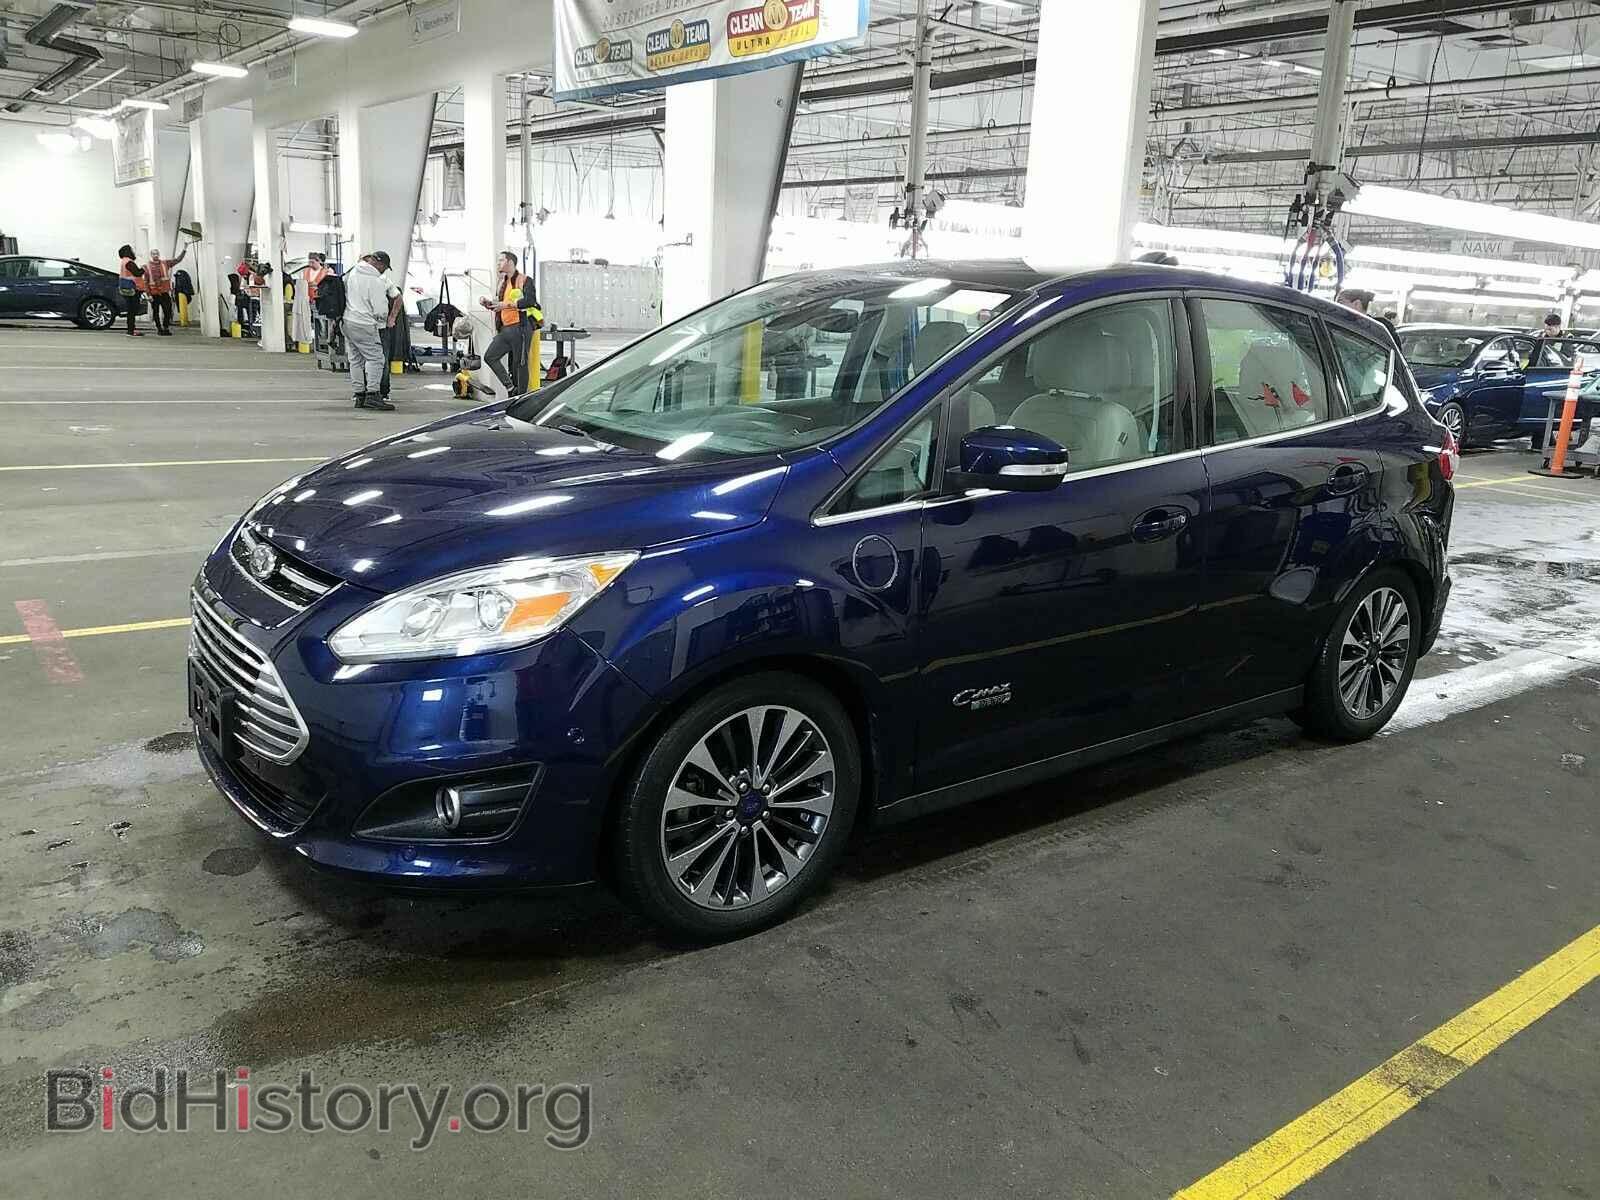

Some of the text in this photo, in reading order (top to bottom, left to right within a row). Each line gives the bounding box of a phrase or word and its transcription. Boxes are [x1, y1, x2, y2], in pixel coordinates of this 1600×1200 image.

[730, 11, 765, 34] CLEAN
[788, 0, 815, 23] TEAM
[647, 31, 669, 53] CLEAN
[685, 22, 708, 44] TEAM
[736, 36, 770, 50] ULTRA
[576, 42, 631, 66] CLEAN TEAM
